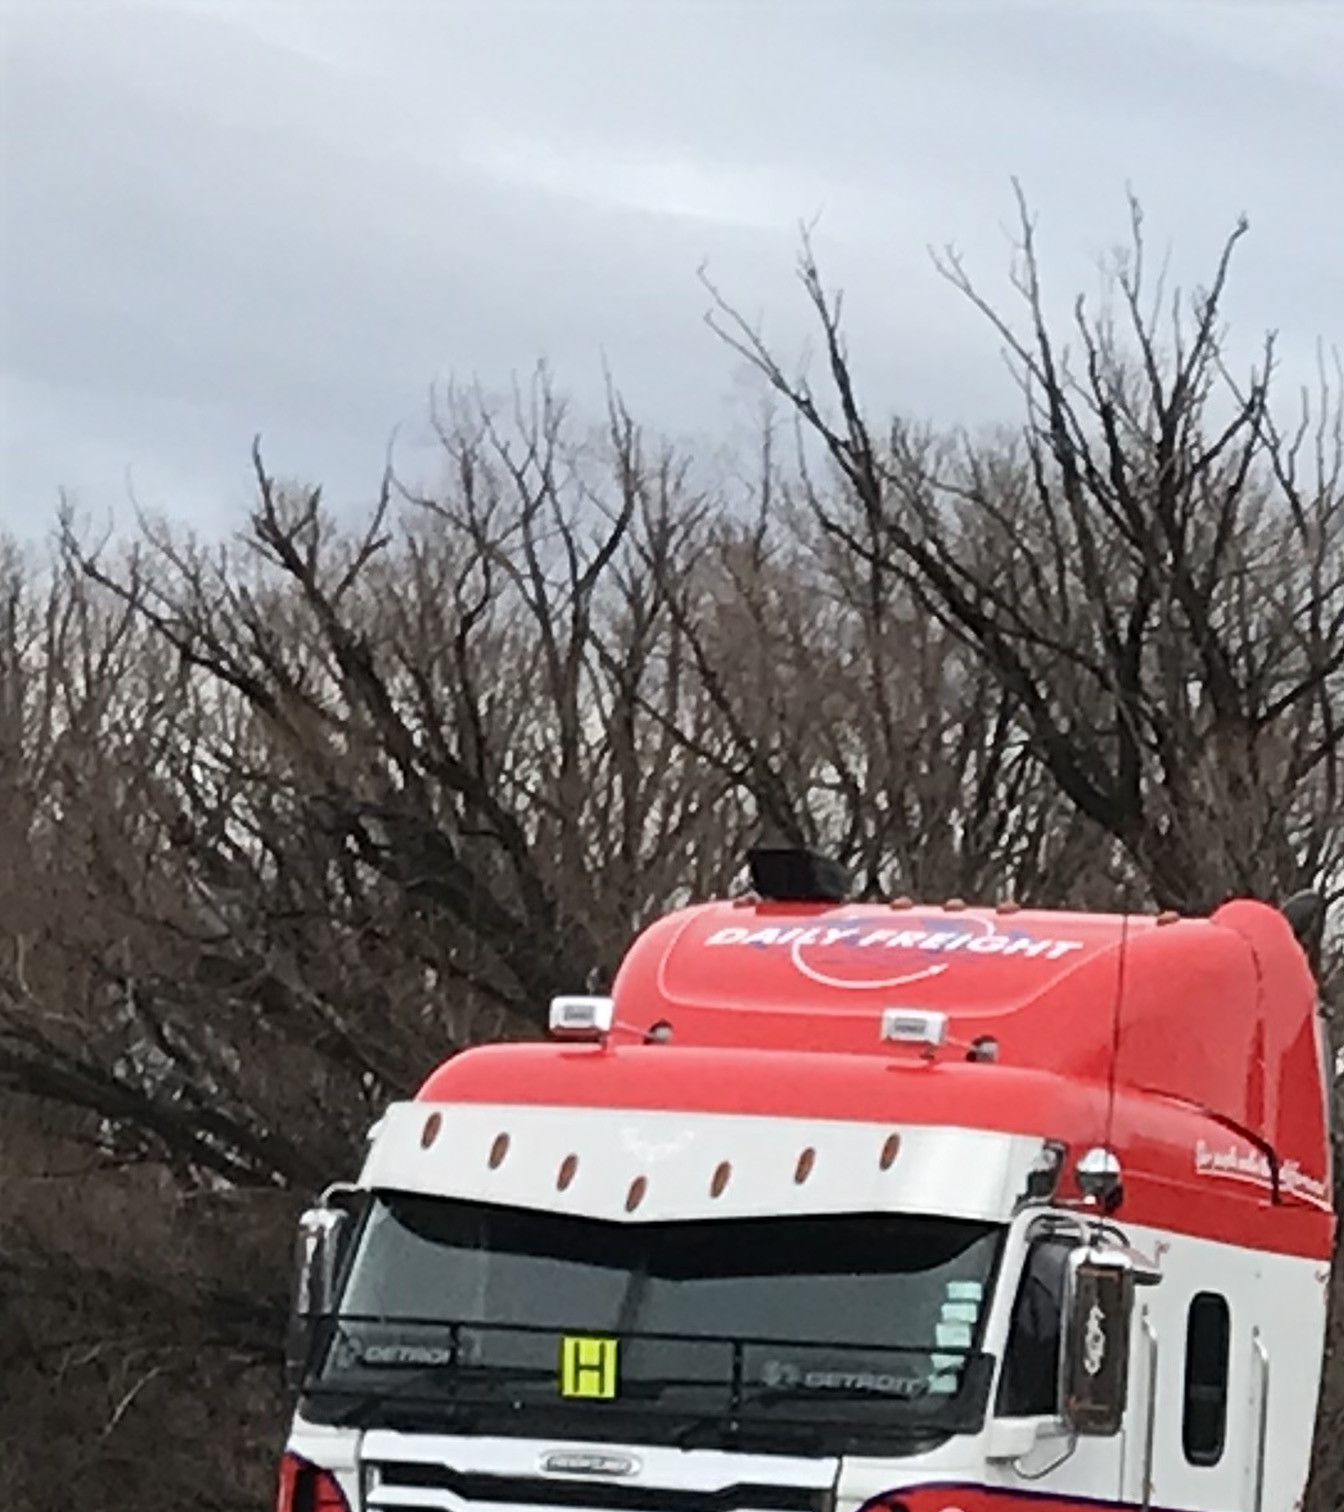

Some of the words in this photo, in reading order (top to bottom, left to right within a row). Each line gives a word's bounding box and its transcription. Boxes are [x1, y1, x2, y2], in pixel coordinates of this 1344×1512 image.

[704, 926, 861, 946] DAILY
[857, 928, 1084, 961] FREIGHT
[574, 1341, 605, 1394] H
